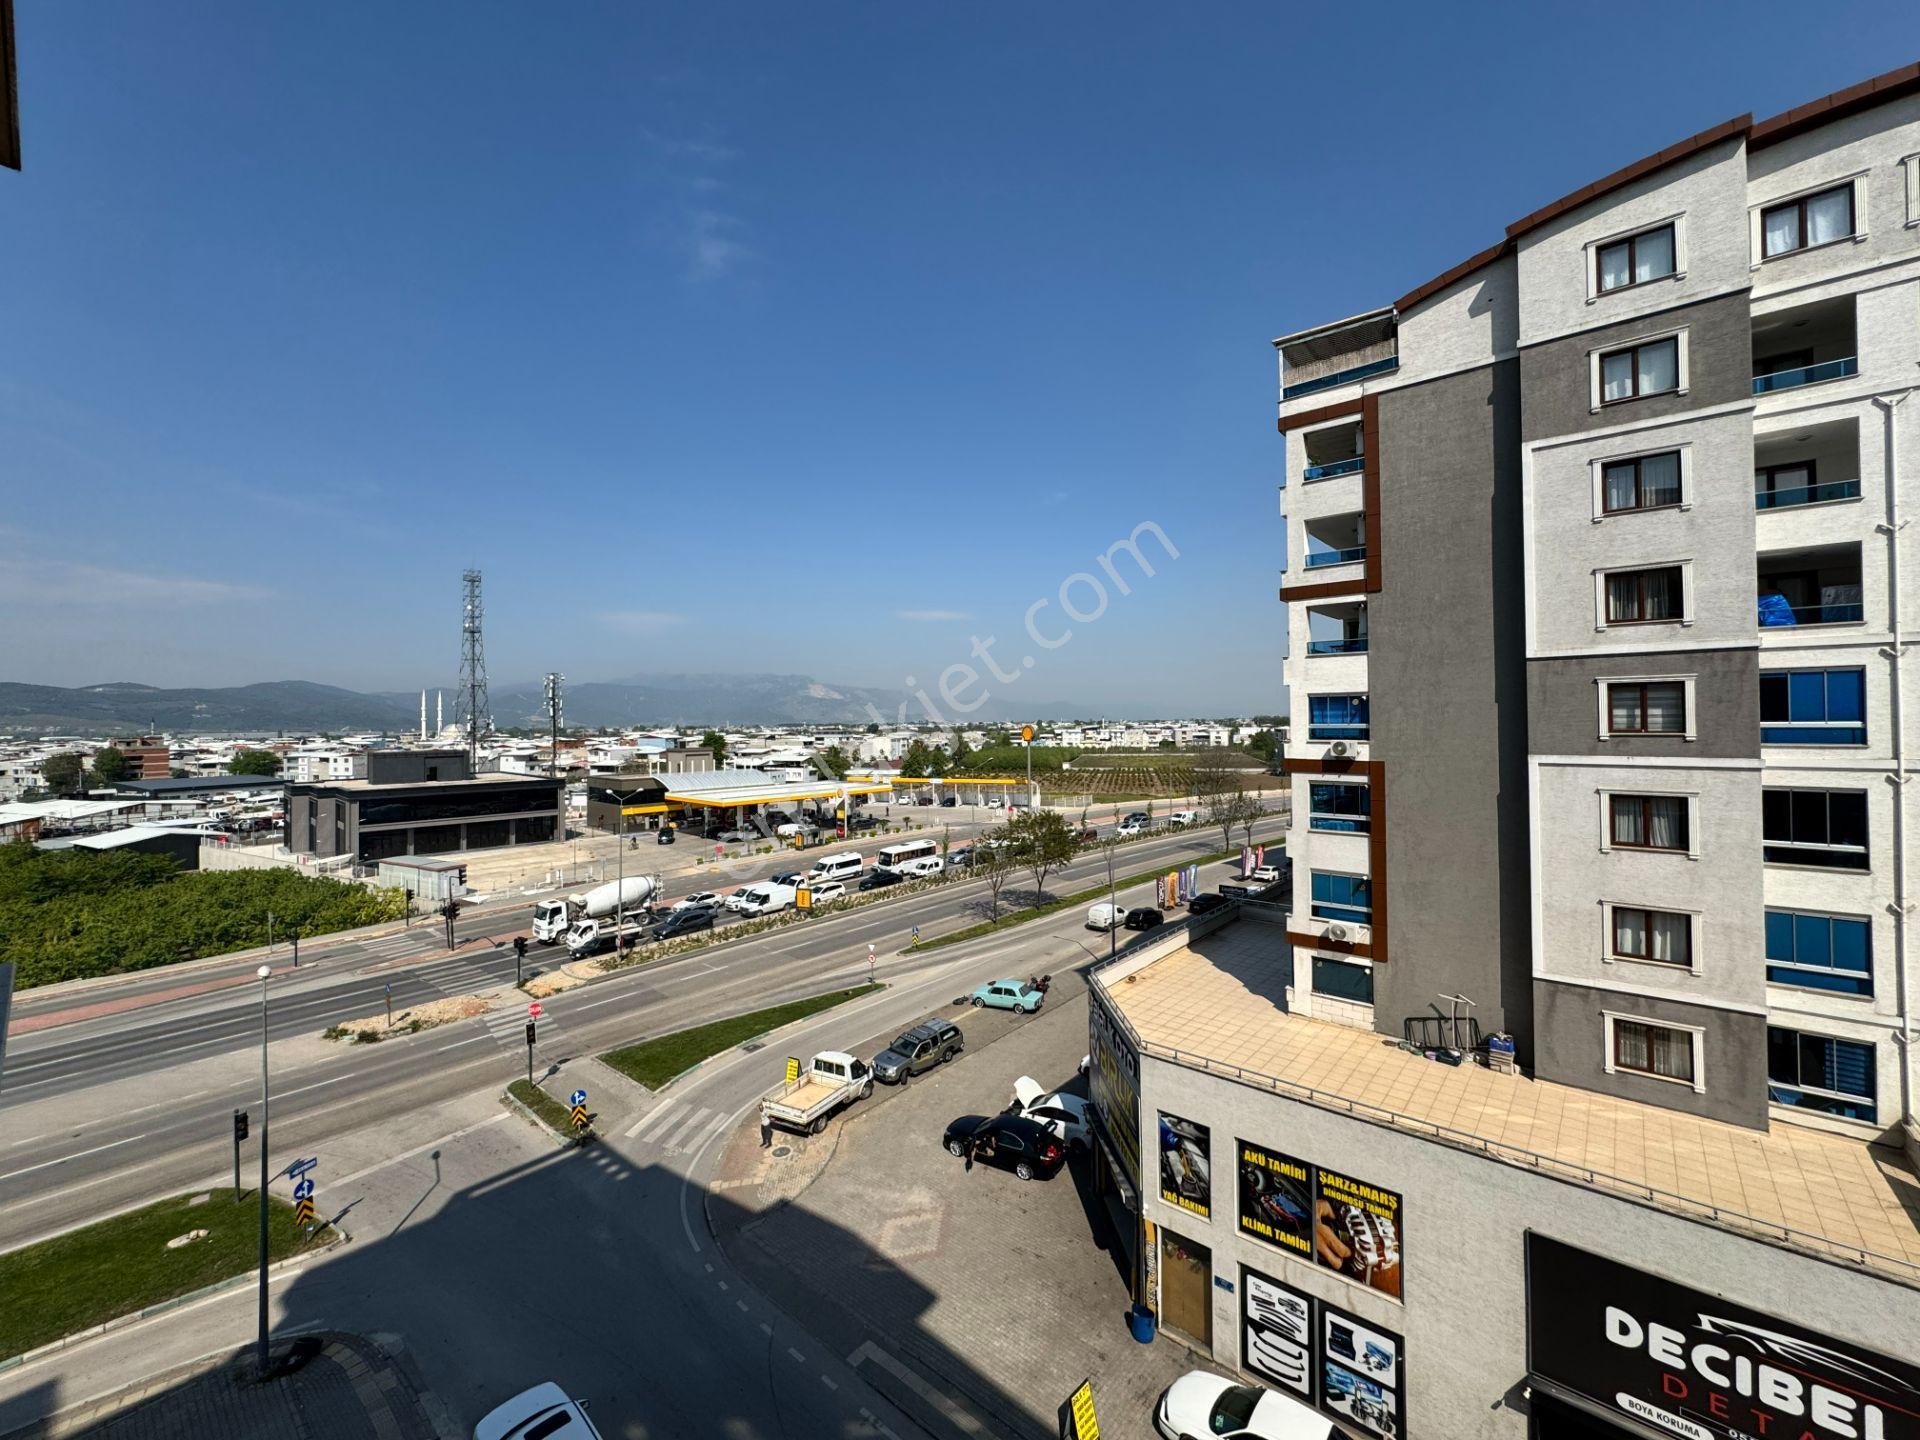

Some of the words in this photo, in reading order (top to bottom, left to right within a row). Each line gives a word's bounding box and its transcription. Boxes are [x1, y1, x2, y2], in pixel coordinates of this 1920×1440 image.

[1244, 1149, 1266, 1167] AKÜ
[1267, 1157, 1307, 1182] TAMİRİ
[1162, 1188, 1178, 1203] YAĞ
[1318, 1170, 1398, 1211] ŞARZ&MARŞ
[1323, 1187, 1365, 1209] DİNOMOSU
[1365, 1202, 1394, 1220] TAMİRİ
[1242, 1215, 1273, 1238] KLİMA
[1274, 1228, 1311, 1254] TAMİRİ
[1628, 1399, 1654, 1418] BOYA
[1656, 1411, 1701, 1438] KORUMA
